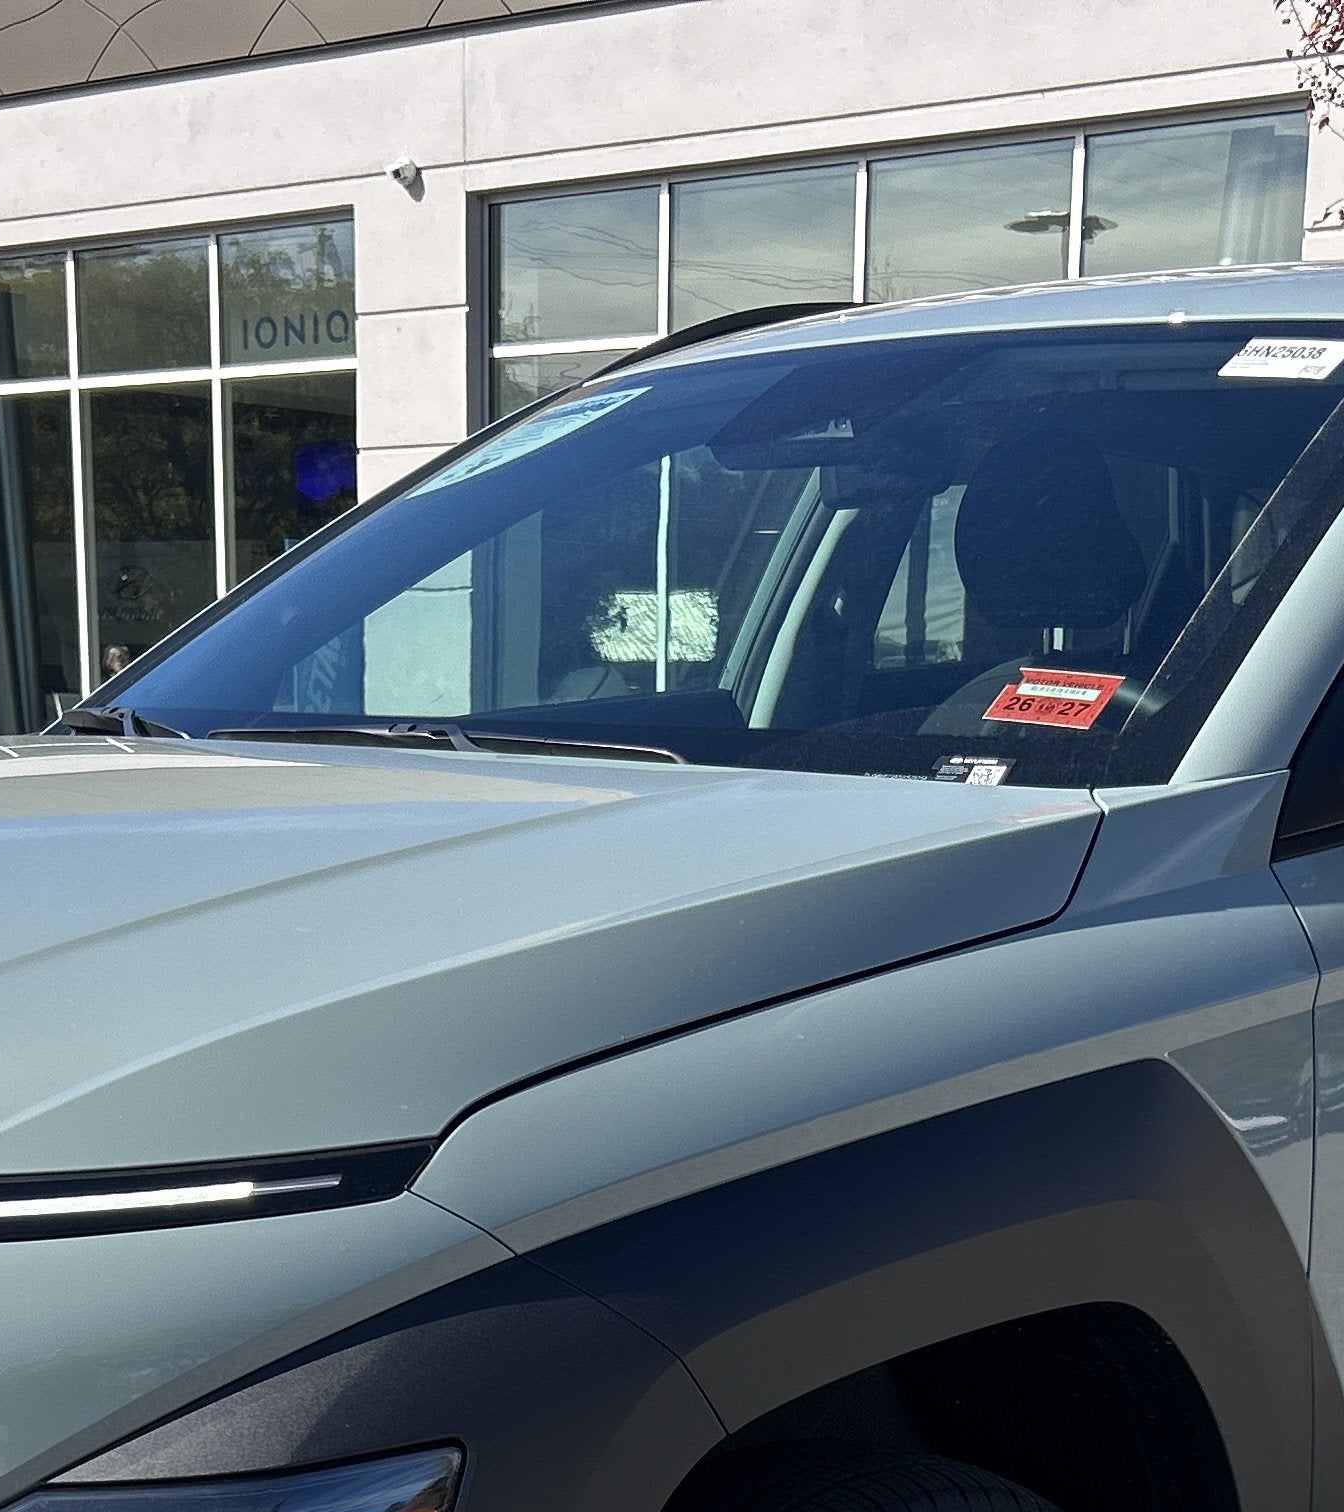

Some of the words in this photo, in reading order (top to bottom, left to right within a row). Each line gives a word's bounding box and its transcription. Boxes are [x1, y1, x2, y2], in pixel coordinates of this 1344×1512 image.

[242, 309, 350, 351] IONIQ
[1003, 696, 1035, 712] 26
[1057, 702, 1092, 718] 27
